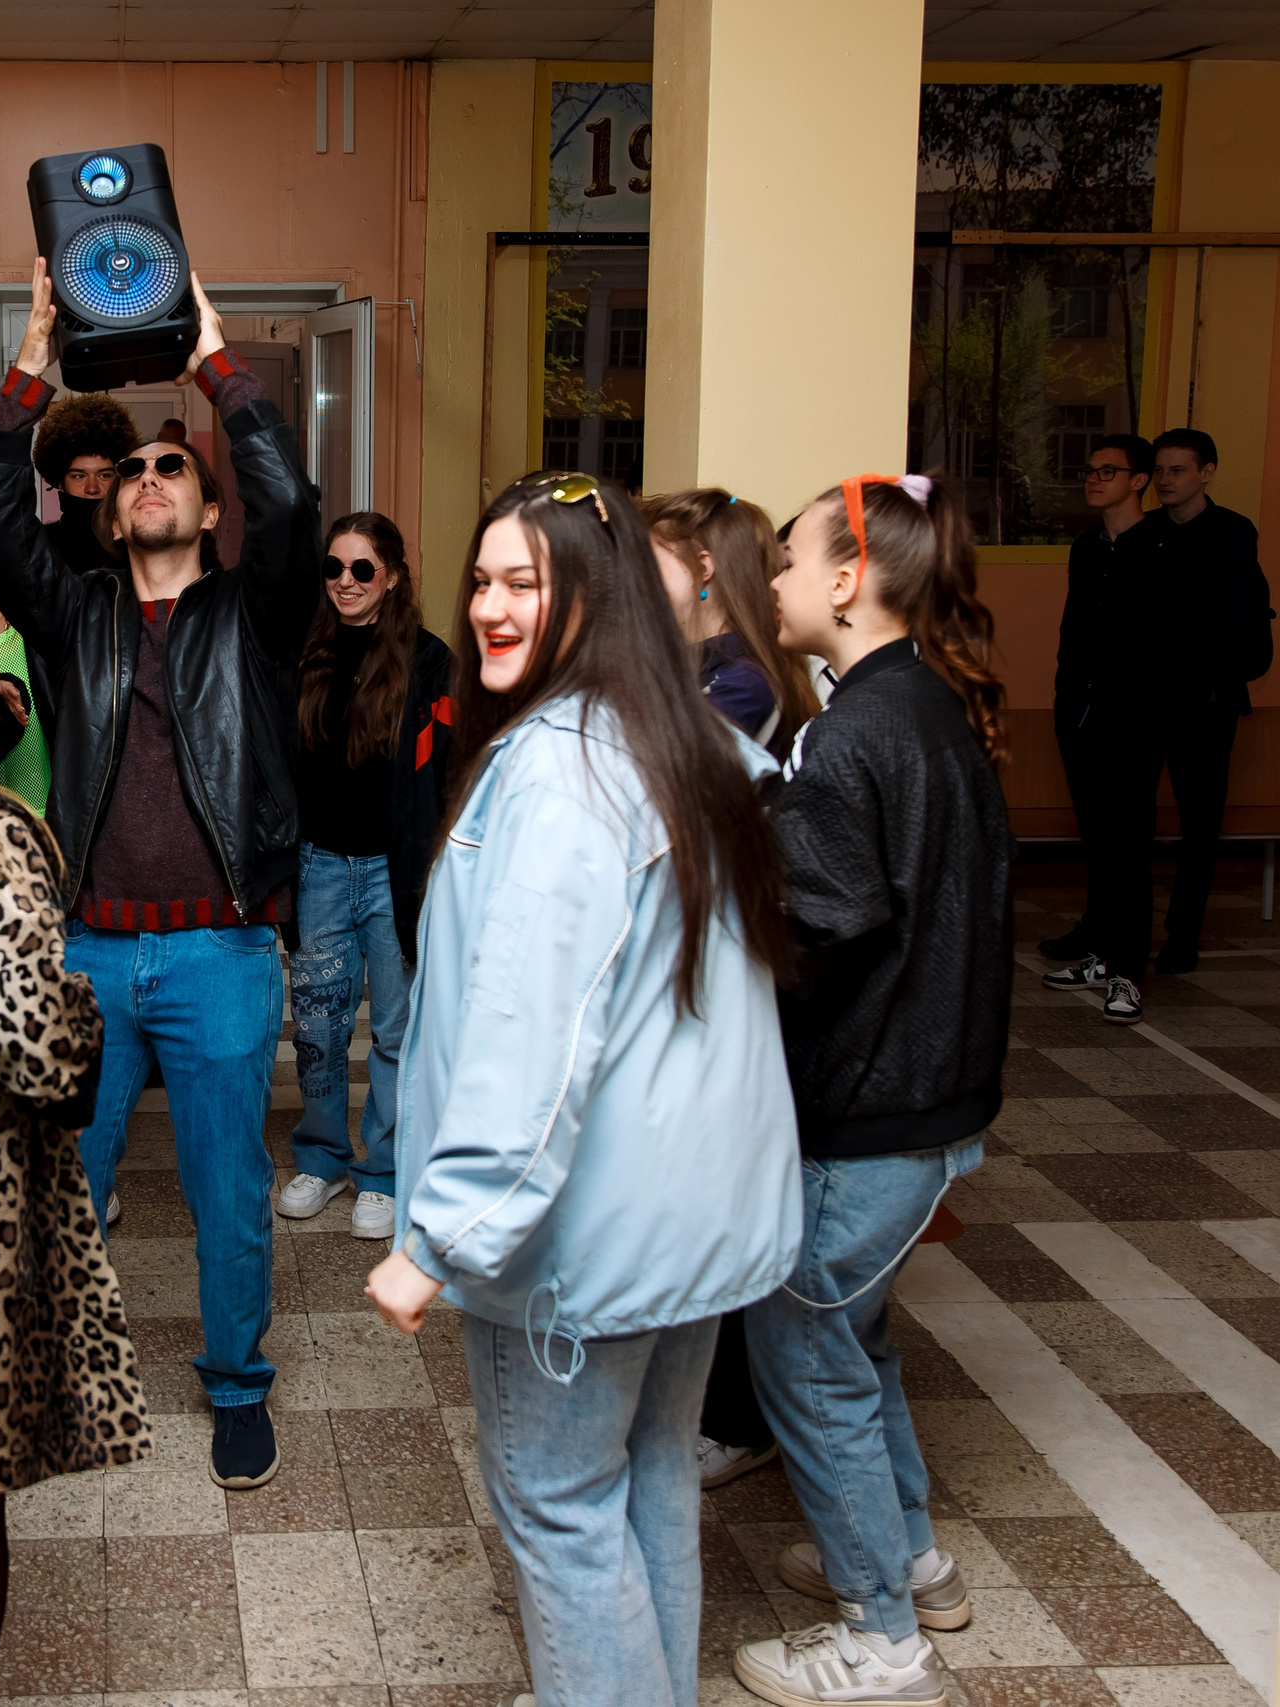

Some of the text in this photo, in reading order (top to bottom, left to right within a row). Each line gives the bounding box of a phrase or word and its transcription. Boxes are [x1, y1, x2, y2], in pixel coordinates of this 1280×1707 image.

[321, 958, 343, 980] D&G
[291, 972, 310, 988] D&G
[292, 993, 340, 1013] Rock
[311, 1009, 329, 1018] D&G
